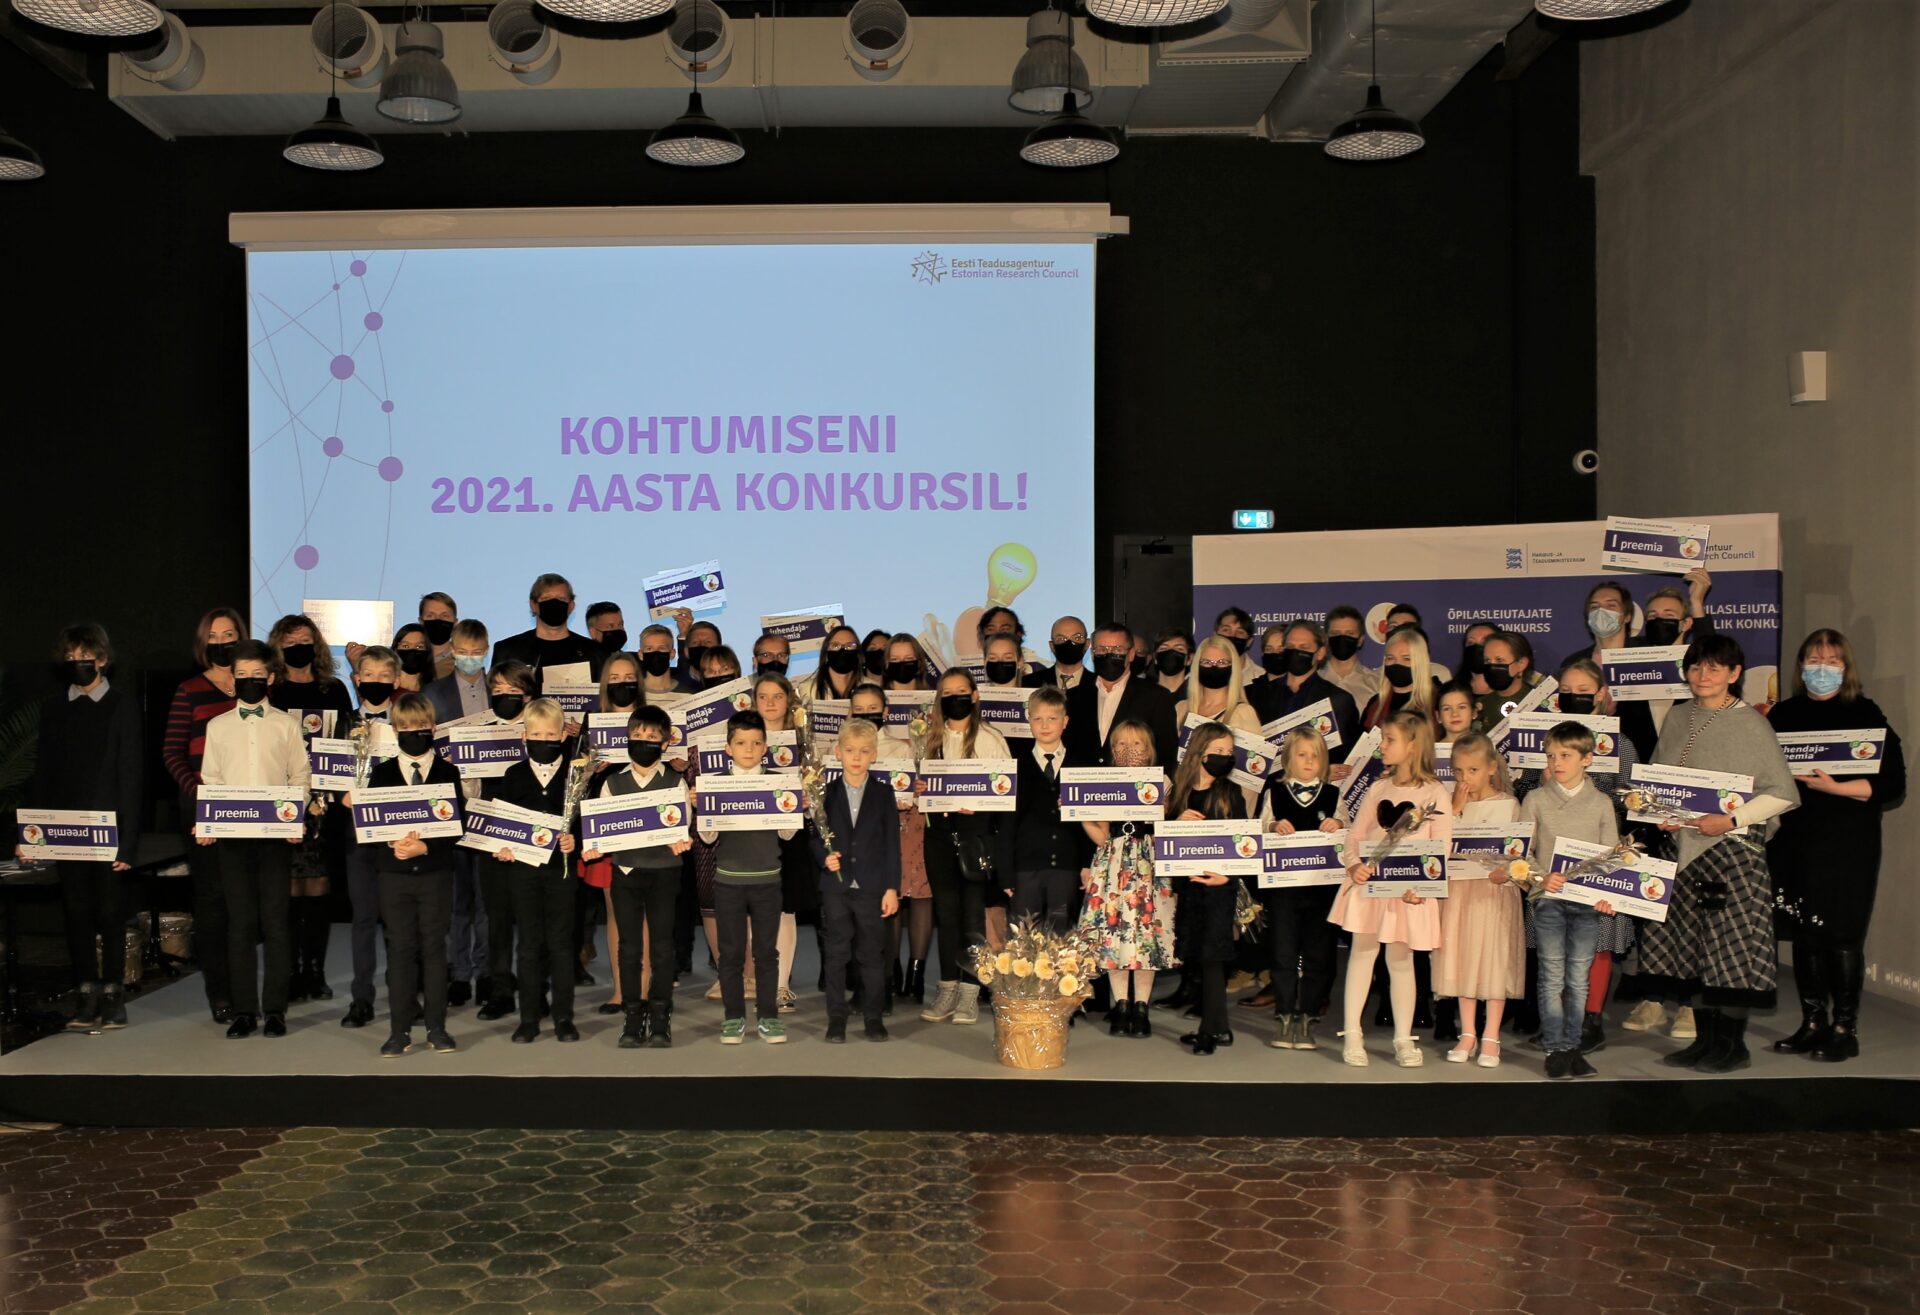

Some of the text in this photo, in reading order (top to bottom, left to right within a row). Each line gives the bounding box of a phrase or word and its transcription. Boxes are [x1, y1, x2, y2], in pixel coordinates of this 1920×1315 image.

[951, 258, 1055, 270] Eesti Teadusagentuur
[951, 269, 1079, 278] Estonian Research Council
[560, 415, 897, 455] KOHTUMISENI
[430, 471, 1029, 514] 2021. AASTA KONKURSIL!
[1620, 540, 1663, 552] preemia
[1721, 550, 1754, 559] Council
[654, 592, 683, 606] preemia
[1448, 608, 1553, 620] ÕPILASLEIUTAJATE
[1620, 669, 1663, 684] preemia
[981, 708, 1020, 719] preemia
[597, 731, 607, 745] II
[1518, 732, 1535, 748] III
[458, 744, 475, 759] III
[478, 747, 521, 760] preemia
[319, 756, 329, 771] II
[707, 753, 723, 769] III
[927, 777, 987, 794] III preemia
[1068, 786, 1127, 804] II preemia
[205, 803, 260, 821] I preemia
[705, 796, 766, 814] II preemia
[361, 807, 429, 823] III preemia
[466, 815, 528, 840] III preemia
[589, 817, 644, 836] I preemia
[47, 827, 109, 844] III preemia
[1163, 840, 1224, 858] II preemia
[1265, 852, 1327, 869] II preemia
[1383, 864, 1420, 879] preemia
[1582, 874, 1634, 892] preemia
